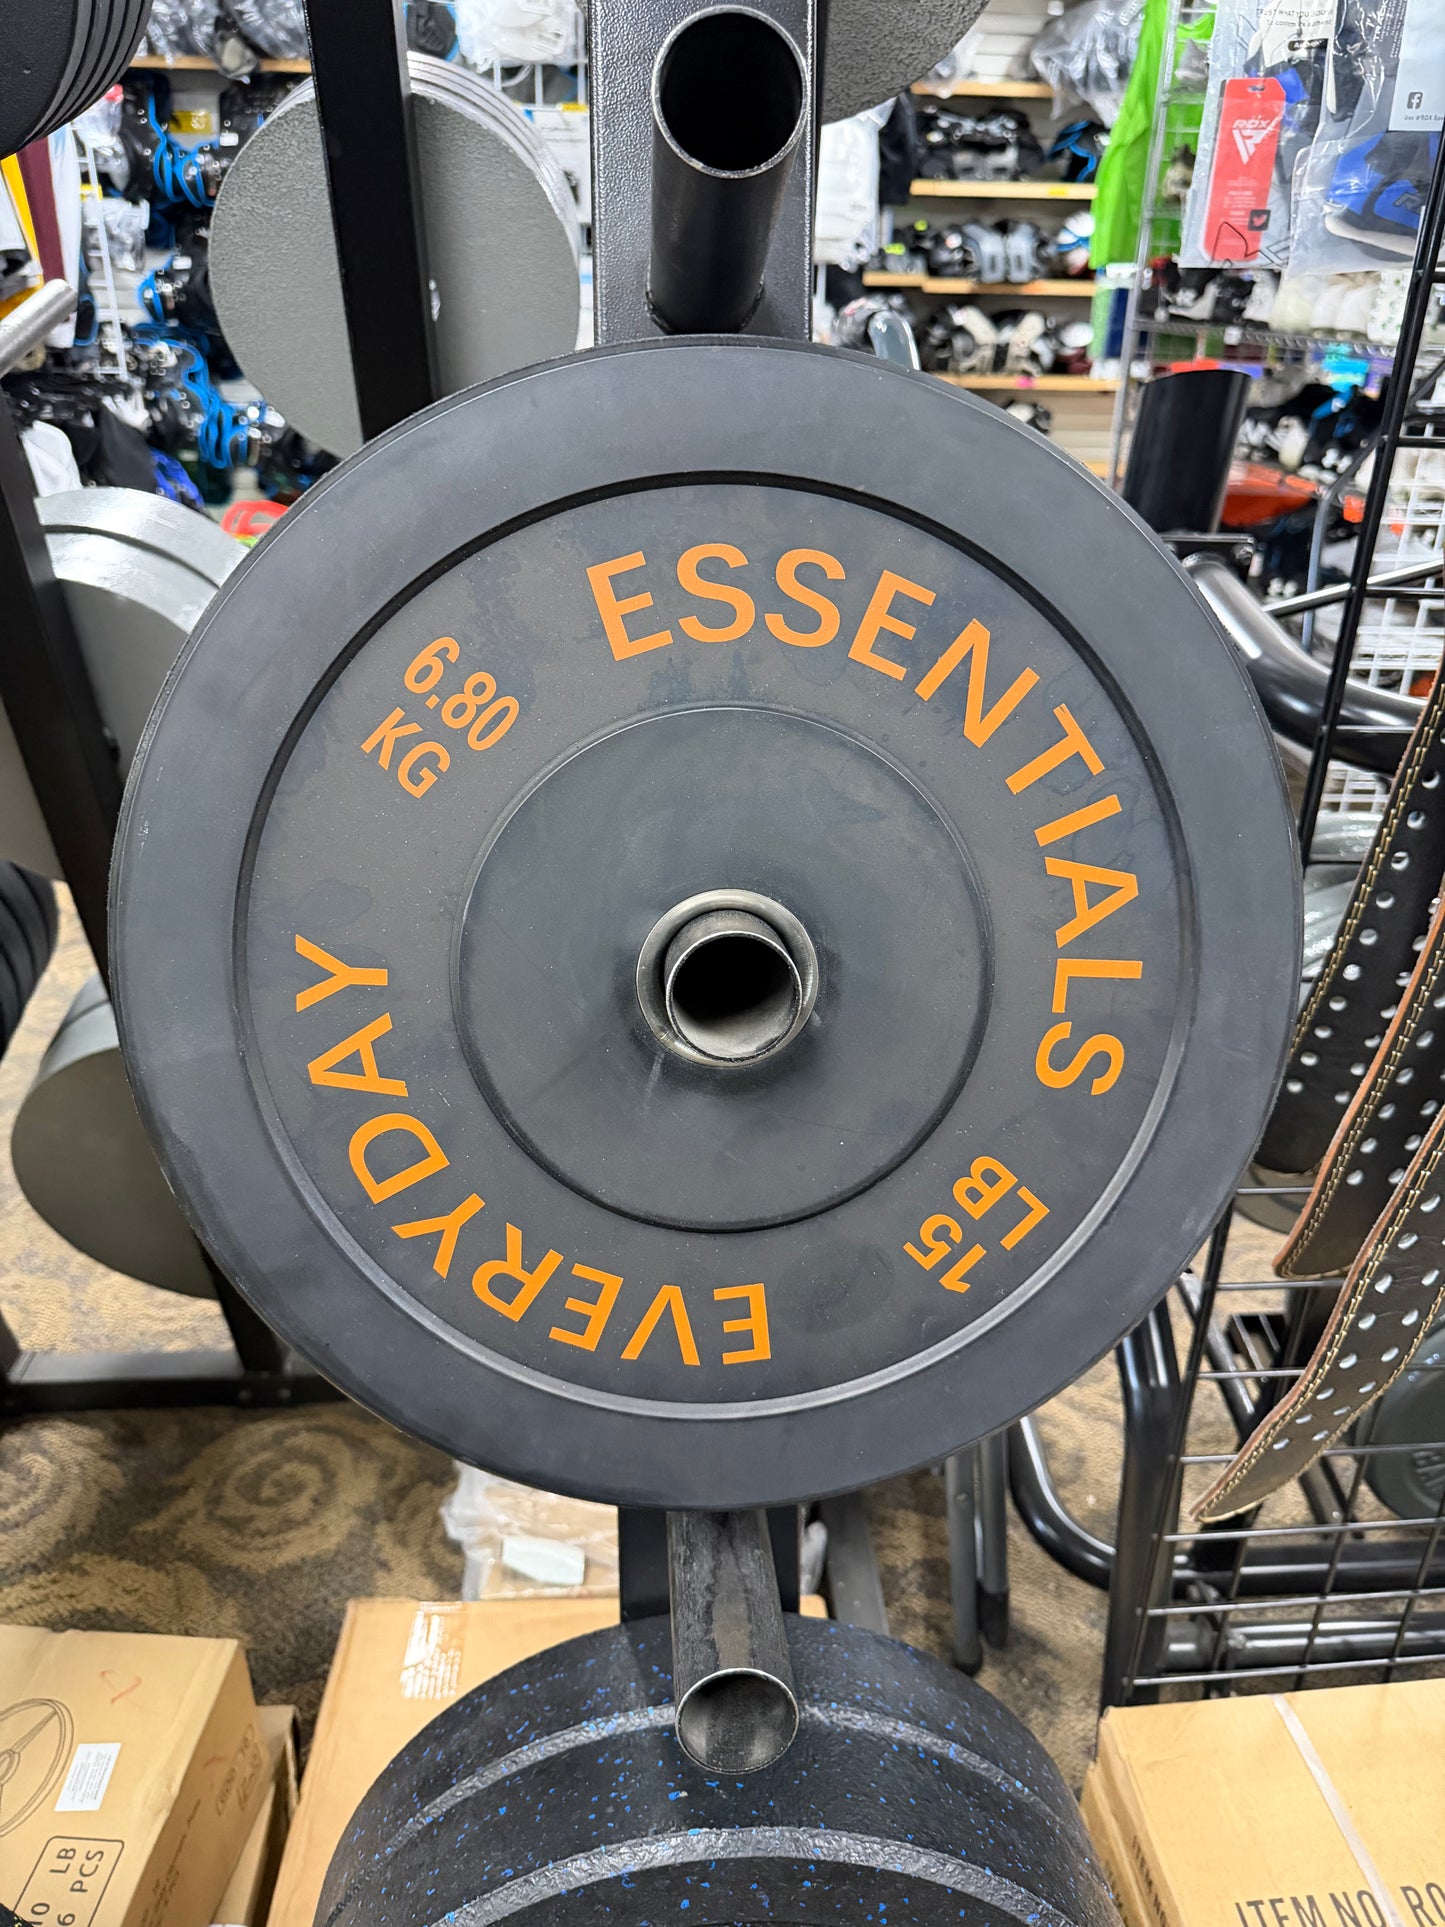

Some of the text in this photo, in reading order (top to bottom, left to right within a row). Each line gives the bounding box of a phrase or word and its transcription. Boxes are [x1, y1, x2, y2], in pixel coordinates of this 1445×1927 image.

[1232, 119, 1270, 128] RDX
[404, 637, 519, 750] 6.80
[361, 707, 450, 798] KG
[588, 544, 1142, 1095] ESSENTIALS
[294, 935, 771, 1367] EVERYDAY
[952, 1156, 1050, 1250] LB
[903, 1214, 987, 1293] 15
[49, 1847, 76, 1874] LB
[70, 1850, 104, 1893] PCS
[1234, 1895, 1327, 1927] ITEM
